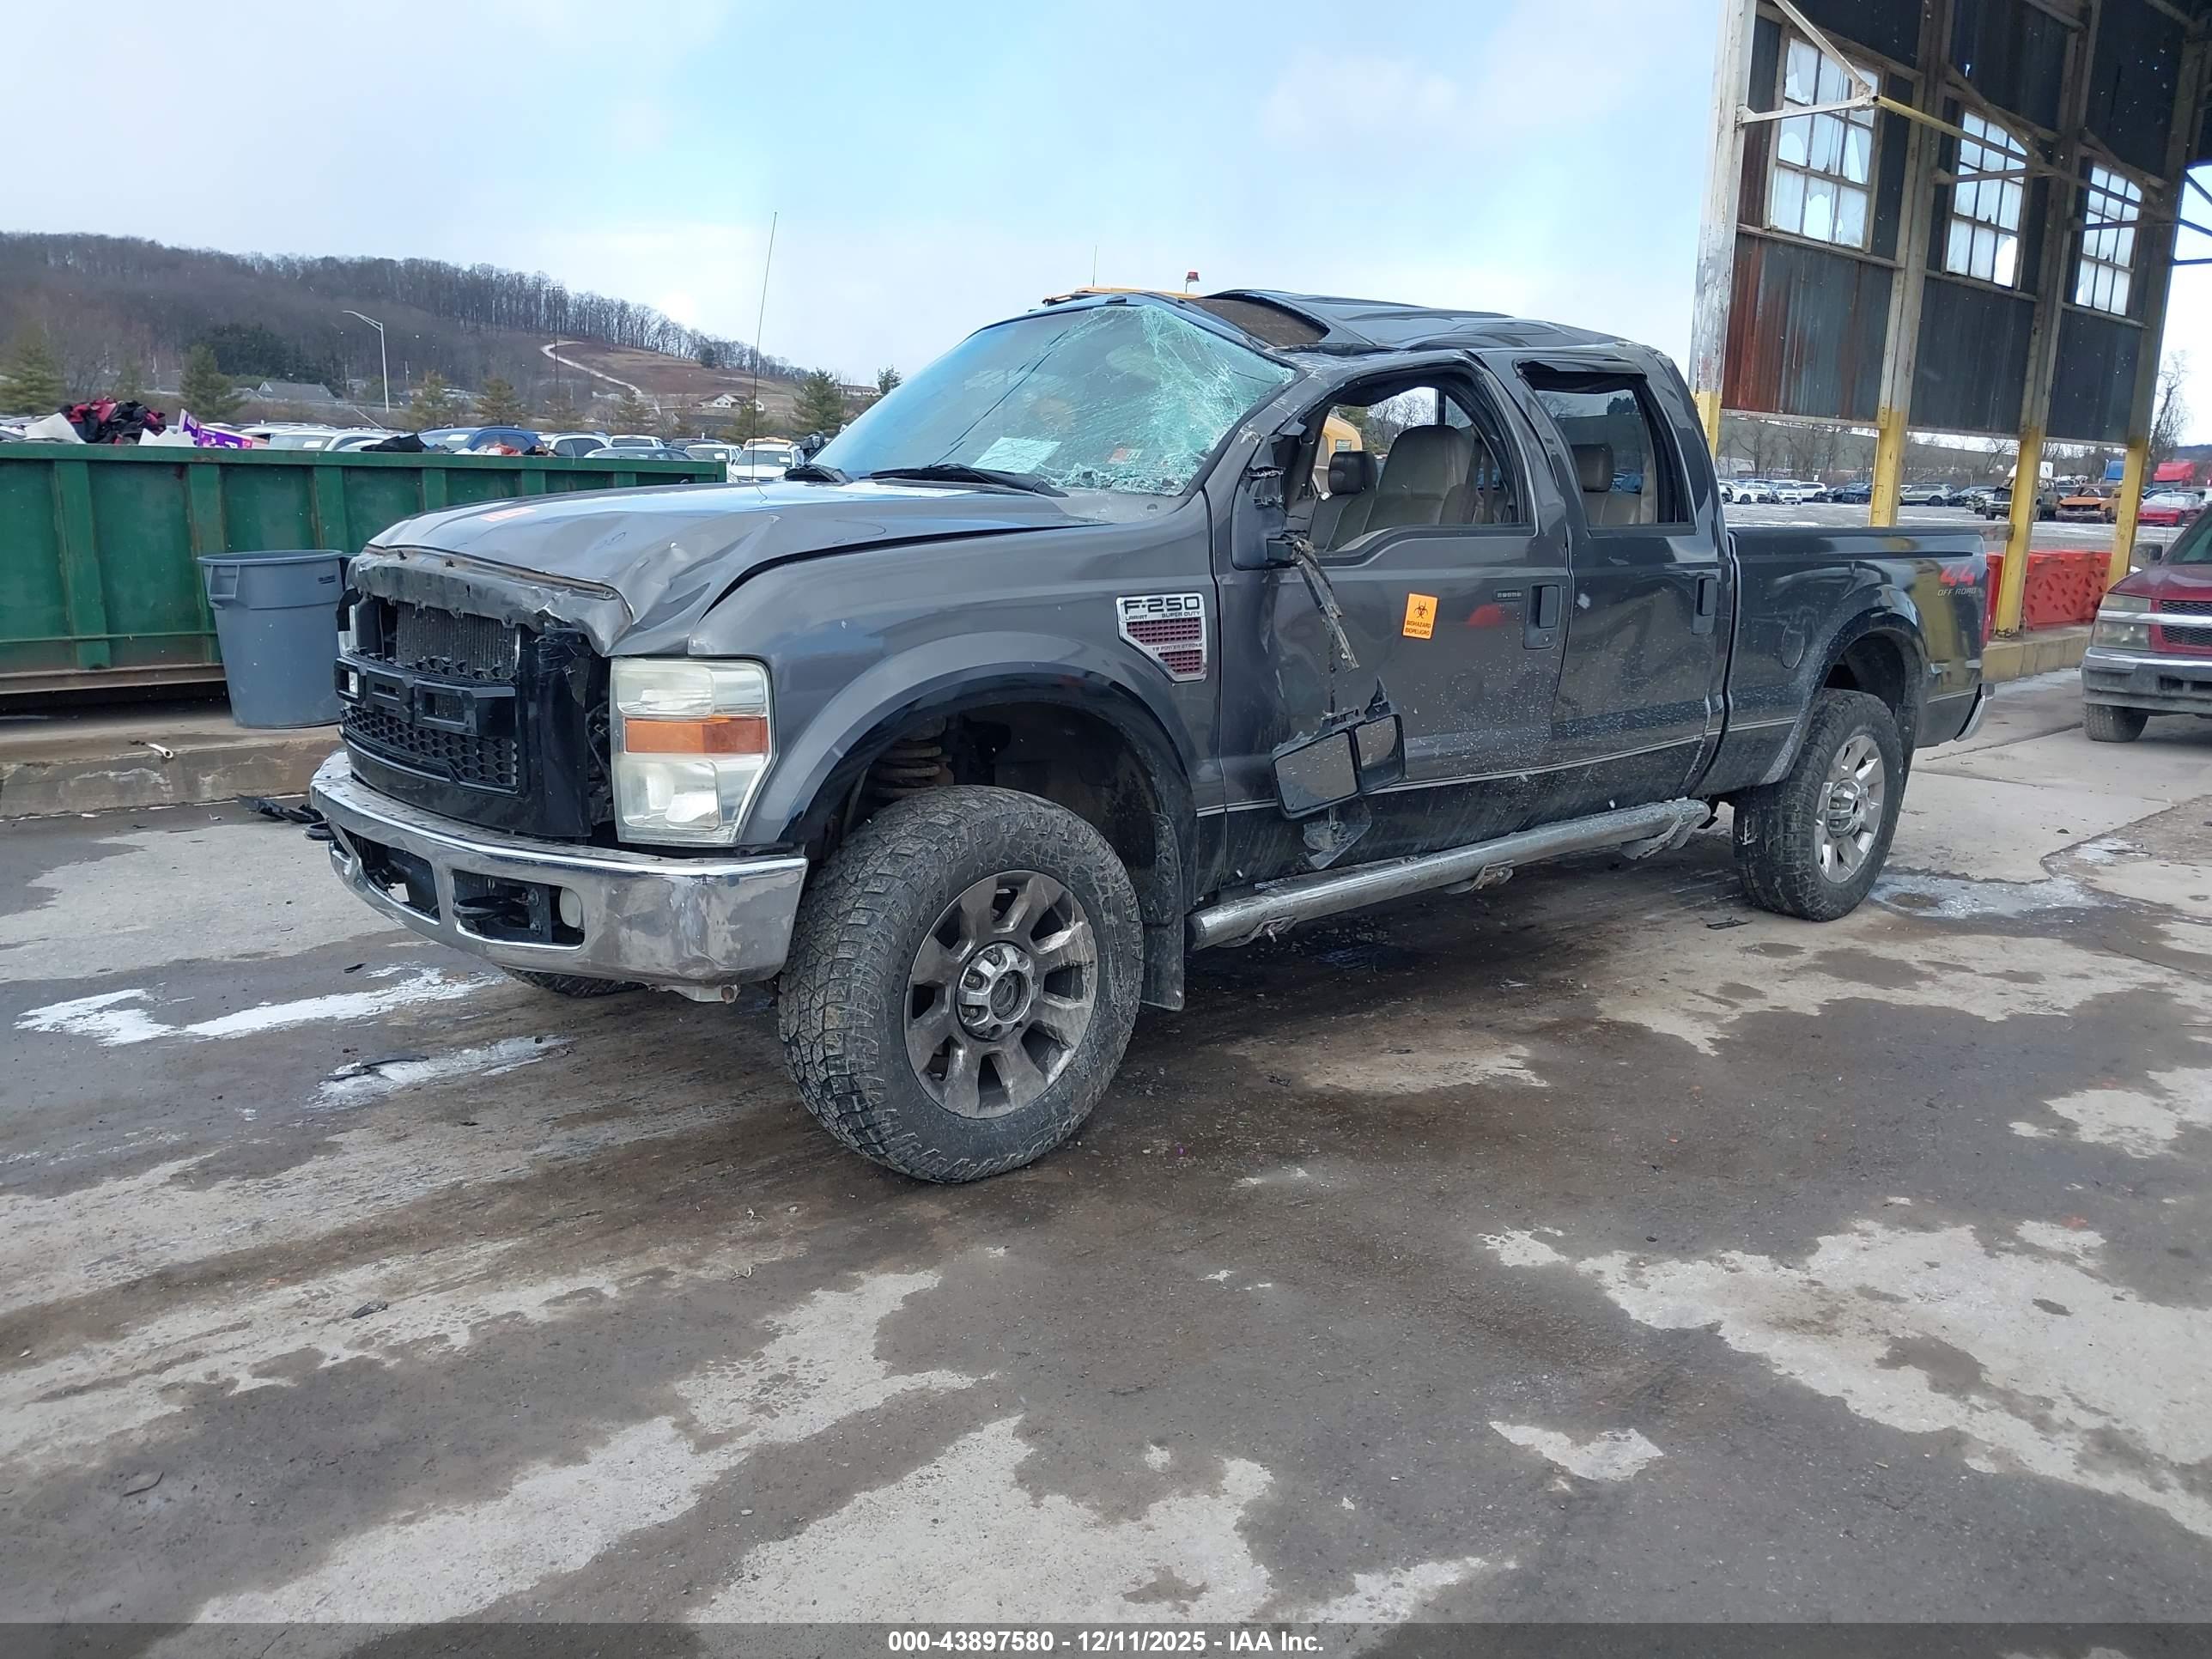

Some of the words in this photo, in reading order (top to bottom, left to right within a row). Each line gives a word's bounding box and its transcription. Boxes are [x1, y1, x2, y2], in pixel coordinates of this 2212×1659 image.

[1937, 588, 1954, 597] OFF
[1123, 596, 1200, 615] F-250
[1406, 620, 1431, 629] BIOHAZARD
